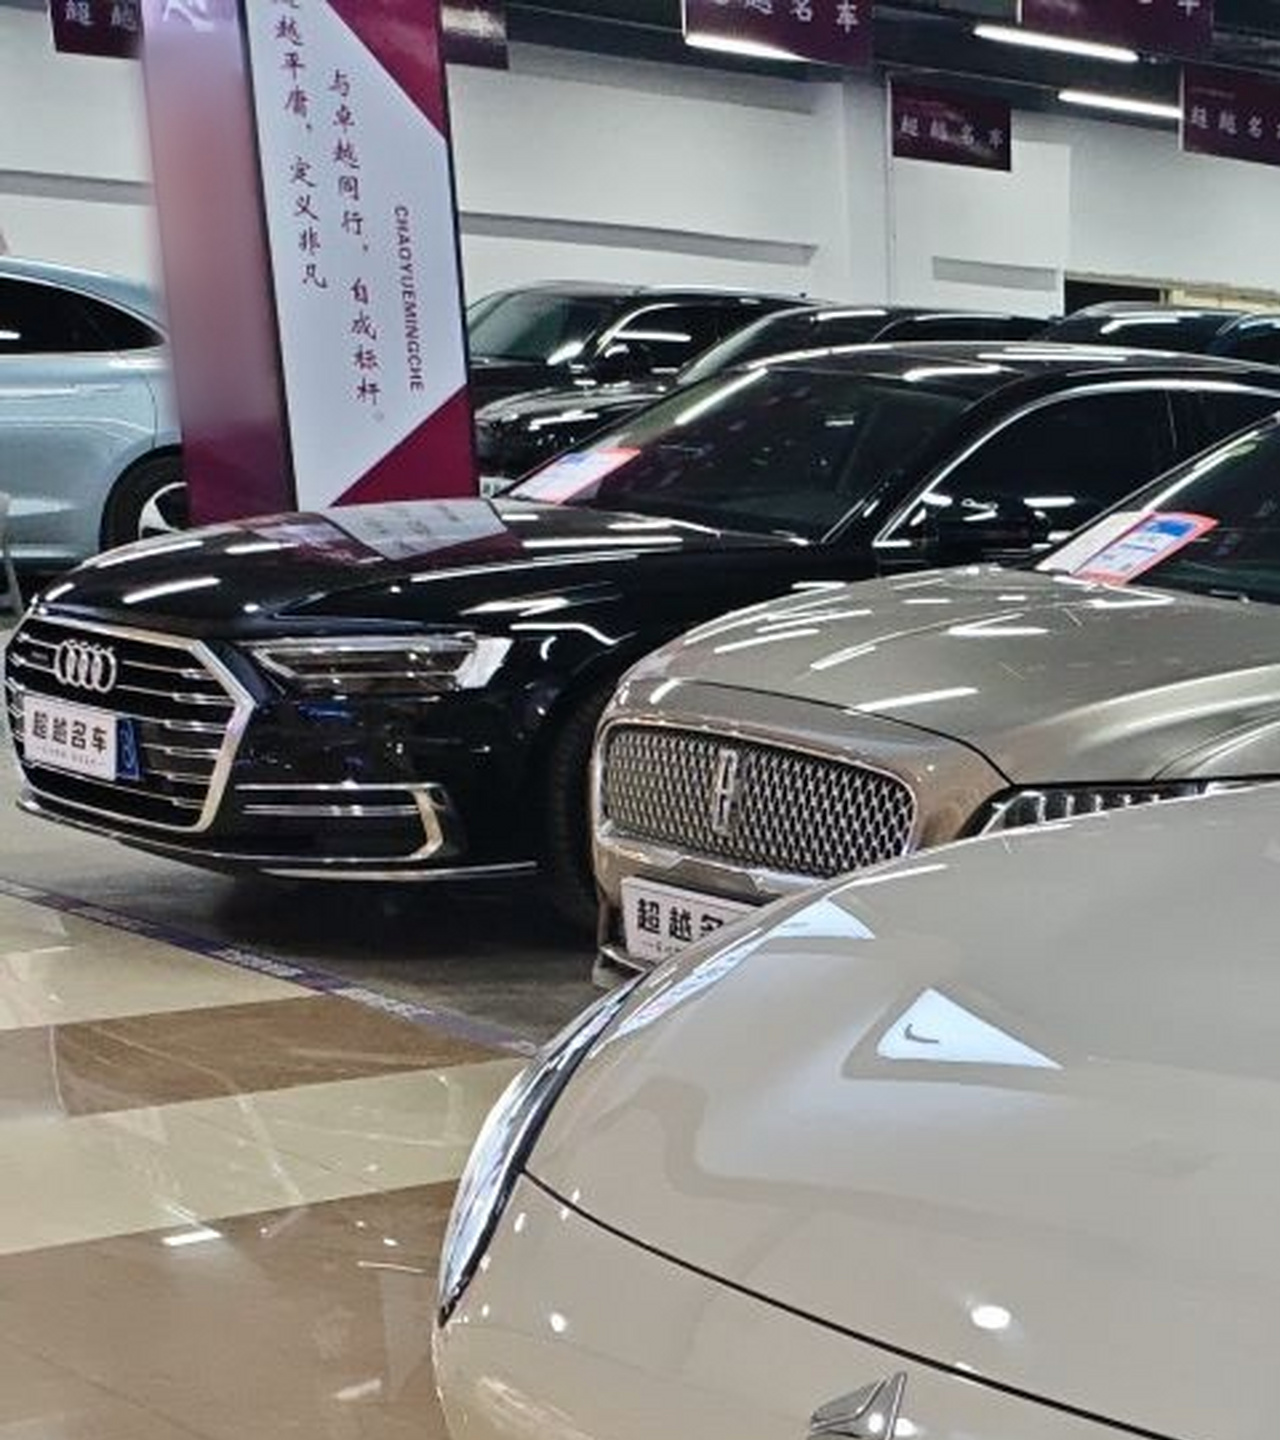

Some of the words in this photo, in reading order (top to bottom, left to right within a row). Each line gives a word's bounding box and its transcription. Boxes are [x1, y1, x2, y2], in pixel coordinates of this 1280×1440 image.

[272, 0, 328, 290] 越平庸，定义非凡
[393, 205, 425, 392] CHAOYUEMINGCHE
